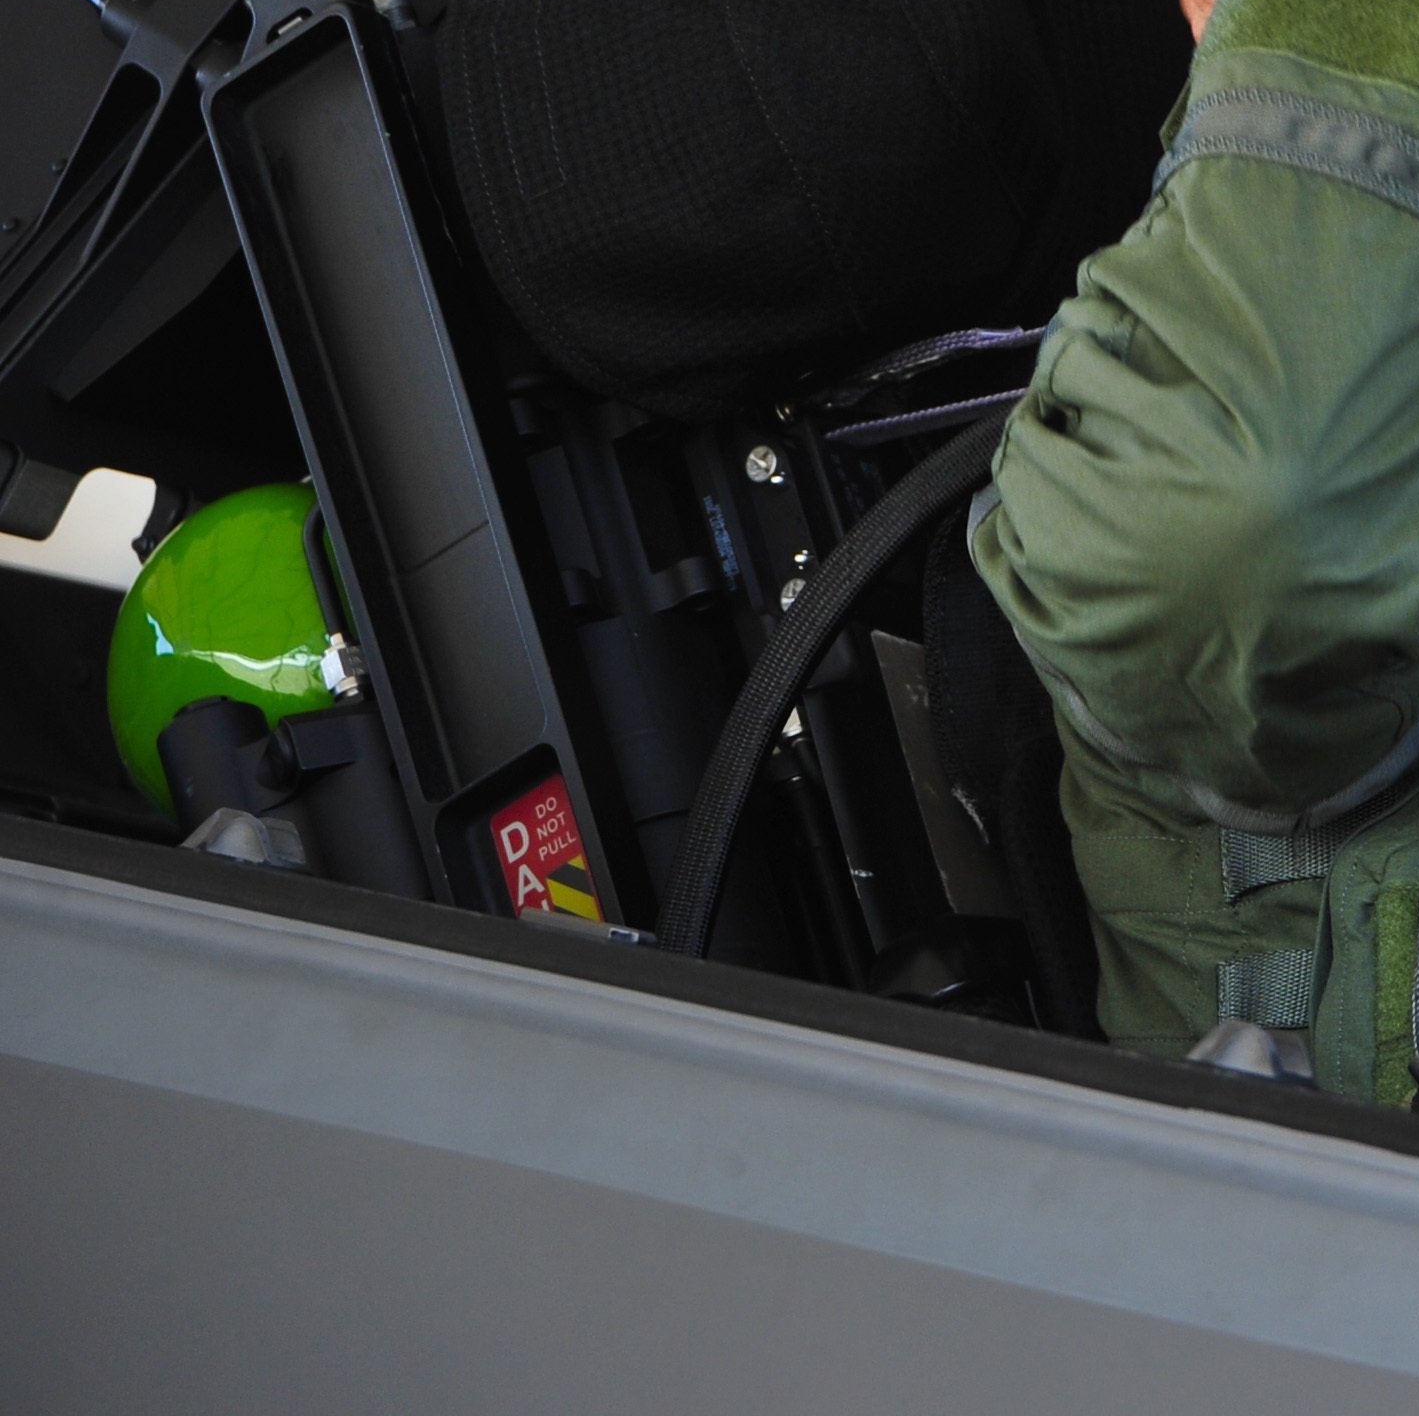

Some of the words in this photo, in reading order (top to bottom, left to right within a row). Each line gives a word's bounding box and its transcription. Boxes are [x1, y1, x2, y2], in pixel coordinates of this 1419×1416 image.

[535, 795, 558, 820] DO
[536, 811, 567, 841] NOT
[538, 831, 577, 862] PULL
